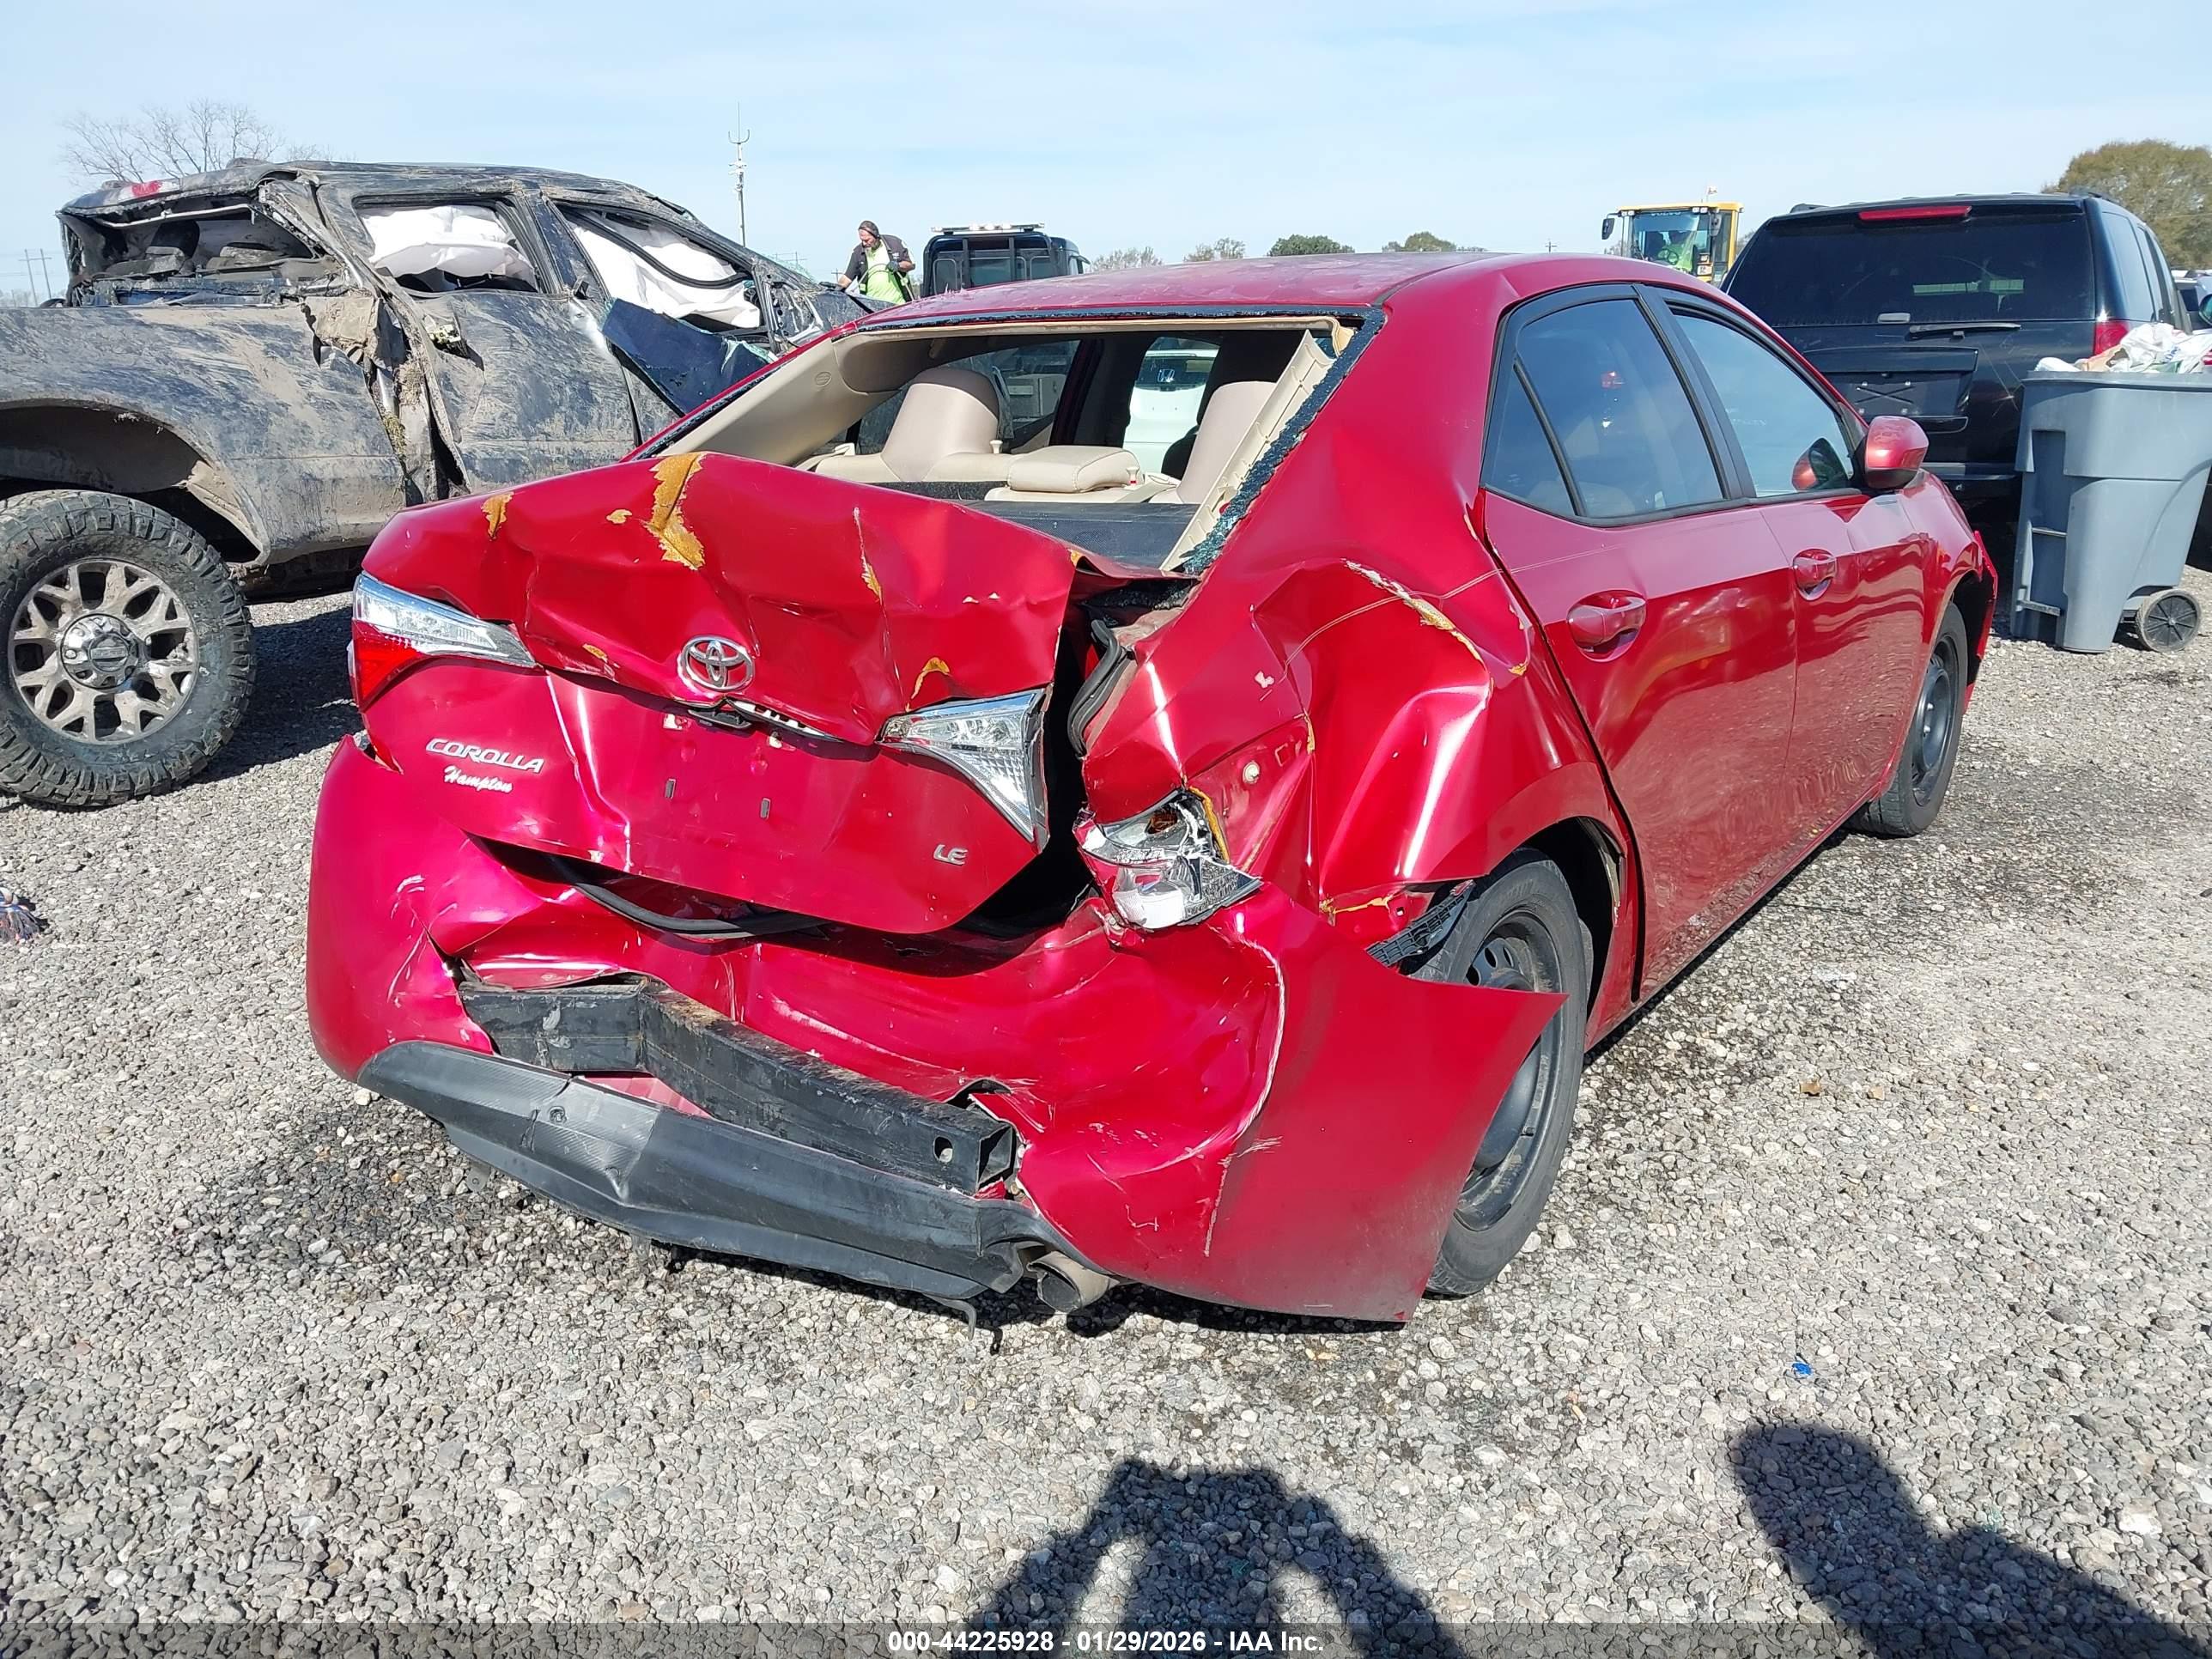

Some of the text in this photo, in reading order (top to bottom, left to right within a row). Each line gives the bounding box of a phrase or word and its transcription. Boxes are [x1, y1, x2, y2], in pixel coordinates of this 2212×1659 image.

[426, 738, 545, 774] COROLLA
[443, 765, 513, 793] Hampton
[933, 843, 969, 866] LE
